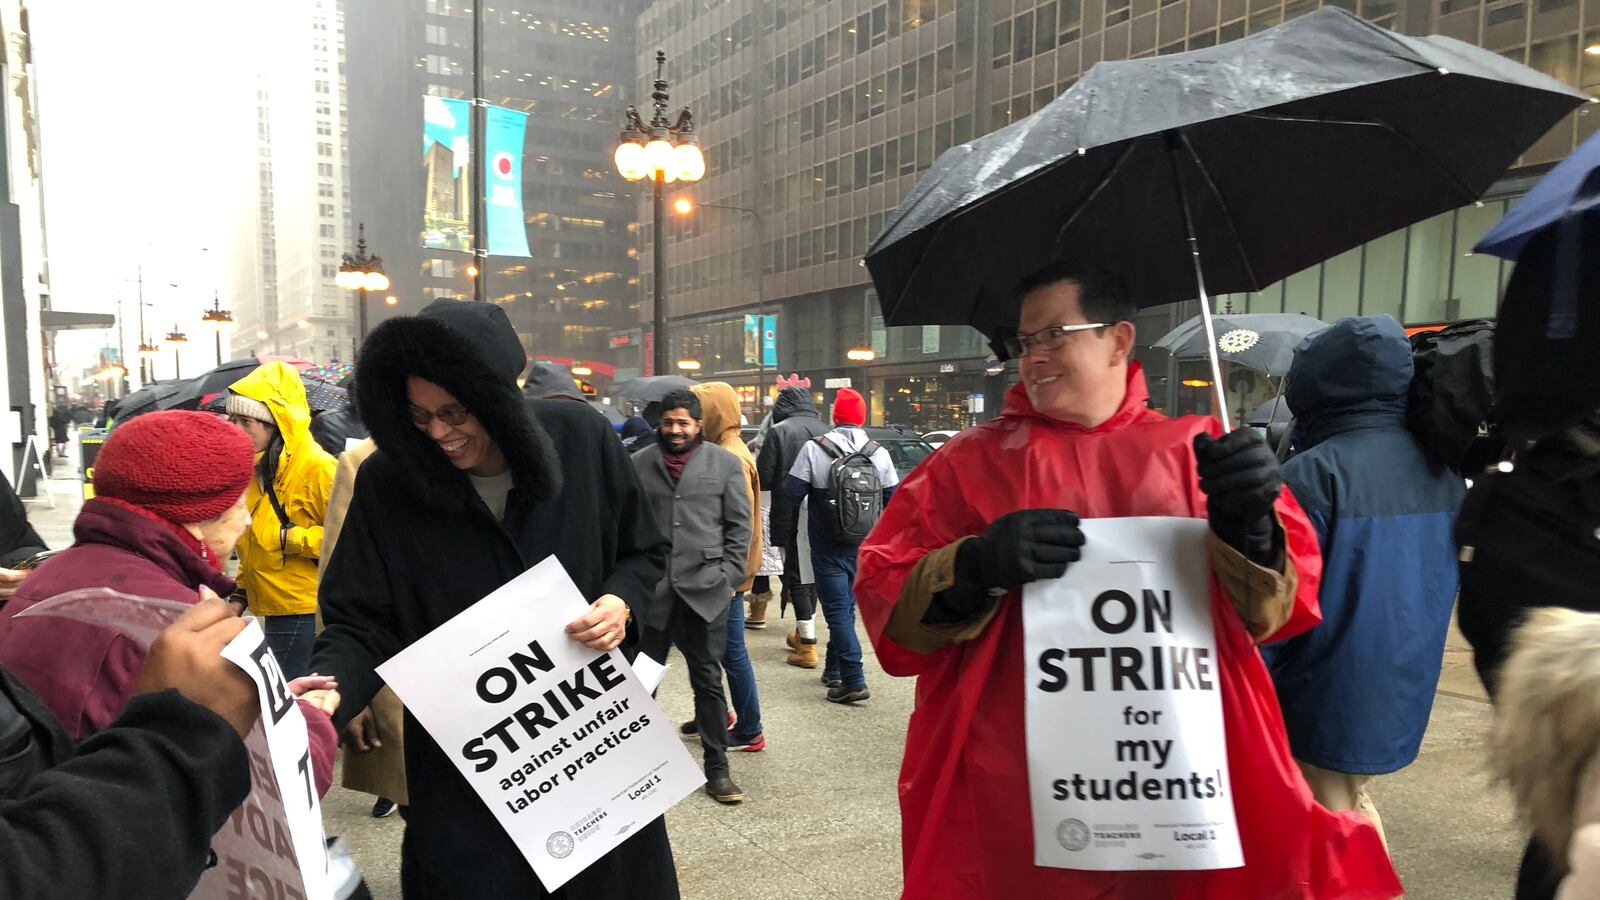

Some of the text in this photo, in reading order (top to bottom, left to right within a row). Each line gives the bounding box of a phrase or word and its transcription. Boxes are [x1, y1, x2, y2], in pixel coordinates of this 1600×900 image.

[1091, 589, 1174, 634] ON
[476, 639, 555, 704] ON
[1038, 646, 1213, 693] STRIKE
[462, 652, 627, 773] STRIKE
[1122, 705, 1162, 726] for
[499, 696, 631, 791] against unfair
[1116, 739, 1173, 769] my
[506, 713, 651, 814] labor practices
[628, 775, 662, 801] Local 1
[1052, 769, 1225, 801] students!
[574, 811, 608, 837] TEACHERS
[1174, 829, 1208, 842] Local
